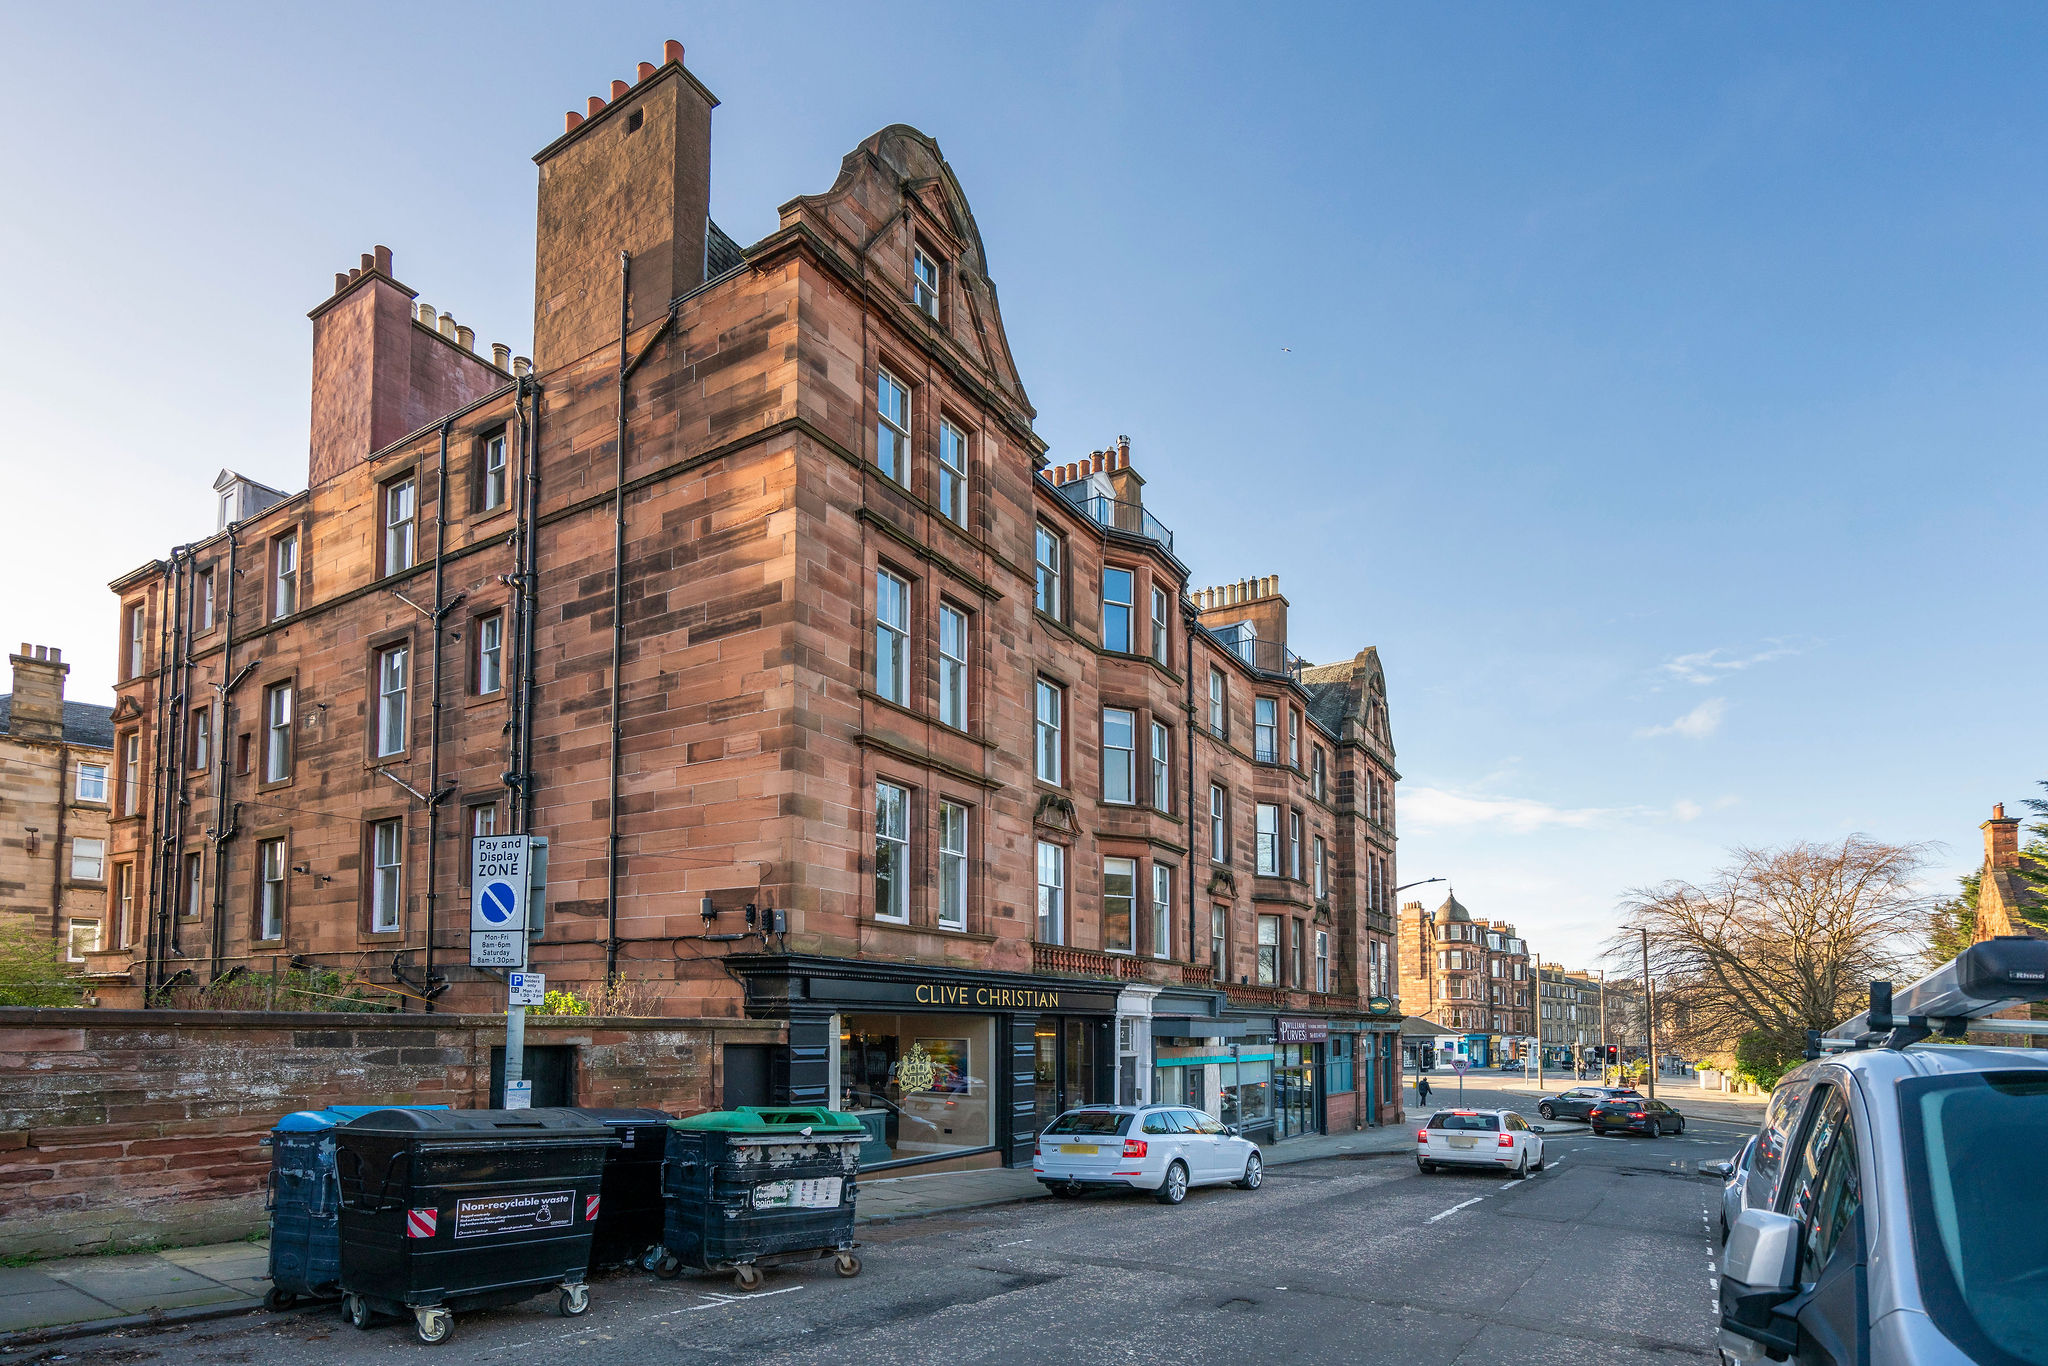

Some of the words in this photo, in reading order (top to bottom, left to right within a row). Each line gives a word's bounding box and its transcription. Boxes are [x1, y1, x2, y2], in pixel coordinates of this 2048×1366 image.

[479, 840, 498, 851] Pay
[501, 838, 521, 849] and
[480, 851, 520, 863] Display
[479, 863, 519, 876] ZONE
[482, 949, 510, 957] Saturday
[915, 984, 969, 1005] CLIVE
[976, 988, 1059, 1008] CHRISTIAN
[1281, 1021, 1305, 1040] PURVES
[1286, 1021, 1305, 1029] WILLIAM
[461, 1197, 540, 1212] Non-recyclable
[540, 1195, 569, 1204] waste
[756, 1198, 774, 1207] point
